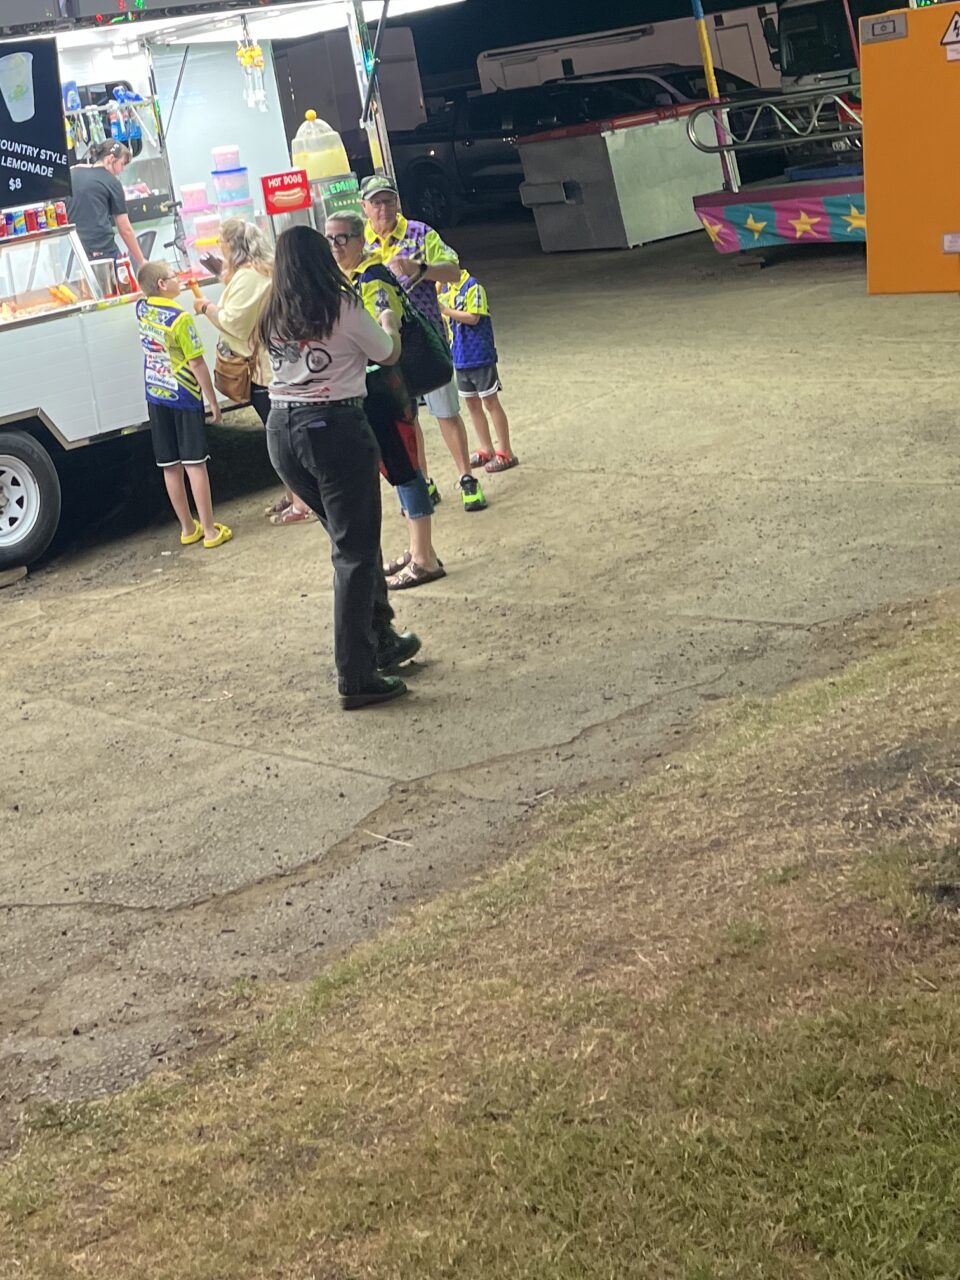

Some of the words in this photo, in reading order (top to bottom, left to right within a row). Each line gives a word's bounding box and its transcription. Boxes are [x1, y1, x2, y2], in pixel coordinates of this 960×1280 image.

[39, 149, 68, 165] STYLE
[1, 155, 54, 178] LEMONADE
[8, 177, 22, 191] $8
[268, 177, 282, 188] HOT
[283, 174, 302, 185] DOGS
